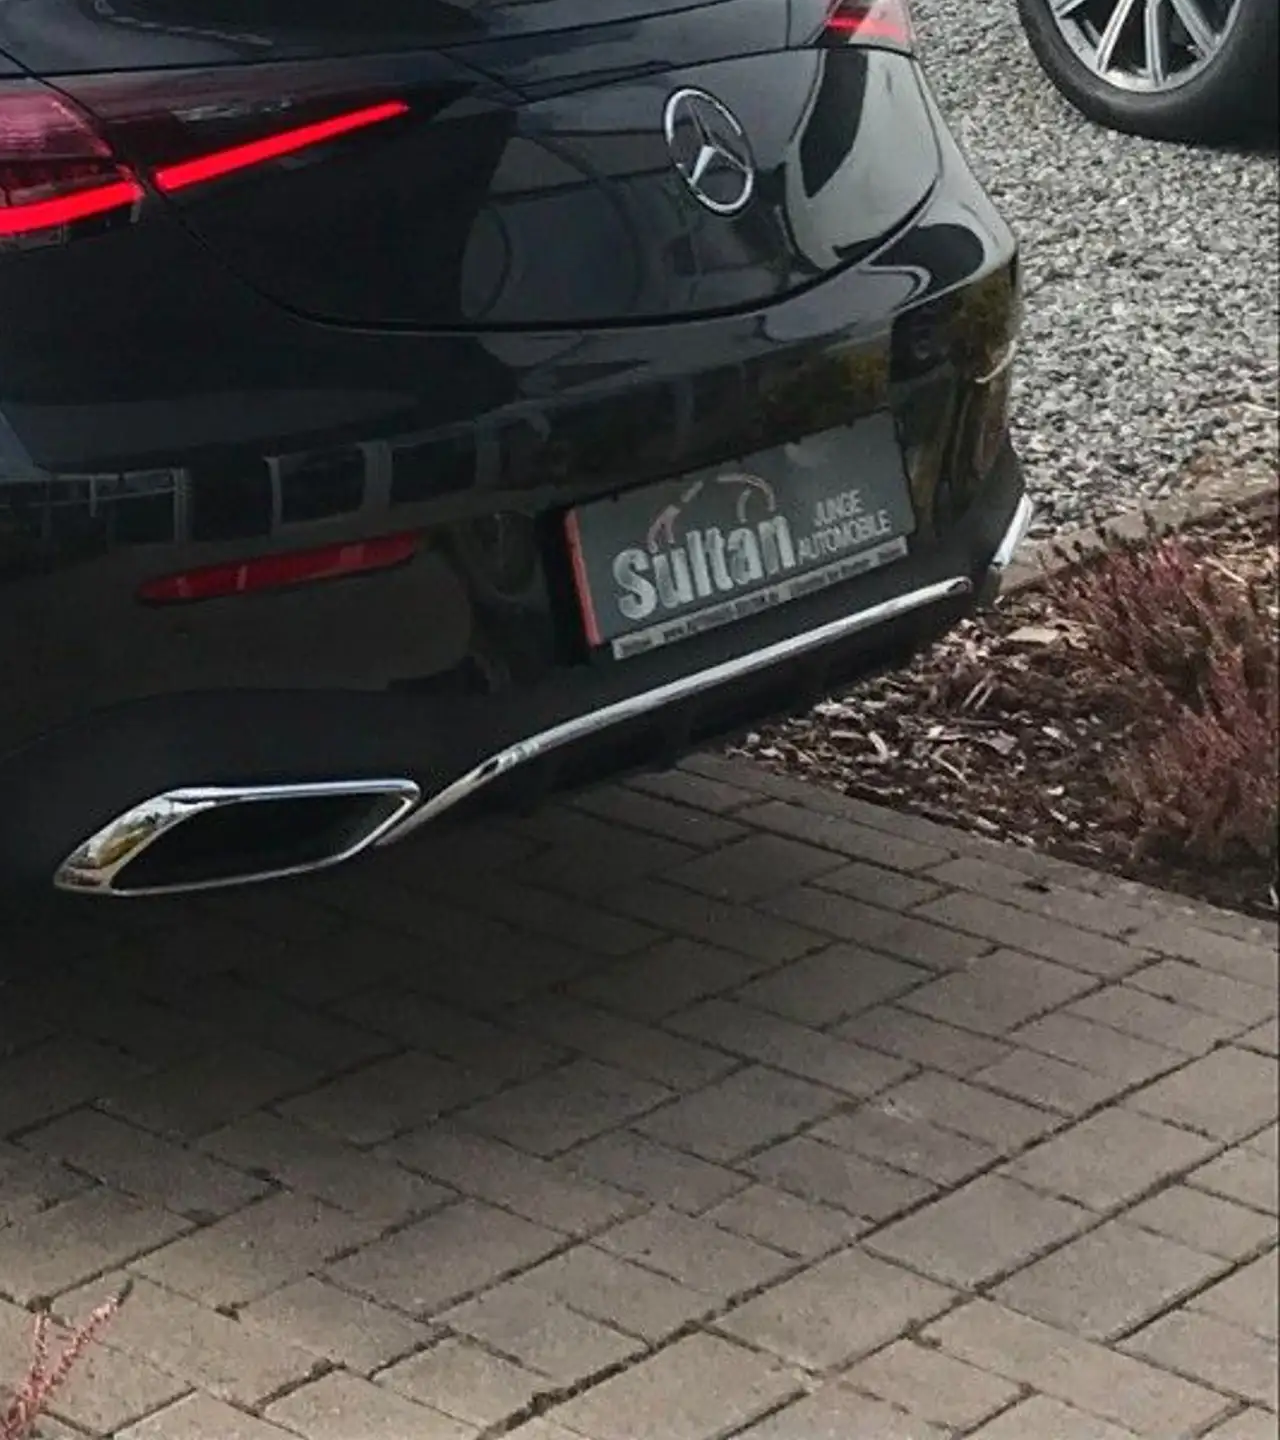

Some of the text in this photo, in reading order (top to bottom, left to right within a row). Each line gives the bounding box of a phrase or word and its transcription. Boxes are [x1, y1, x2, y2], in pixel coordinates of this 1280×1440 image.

[814, 489, 863, 526] JUNGE
[798, 509, 892, 565] AUTOMOBILE
[612, 515, 797, 621] Sultan
